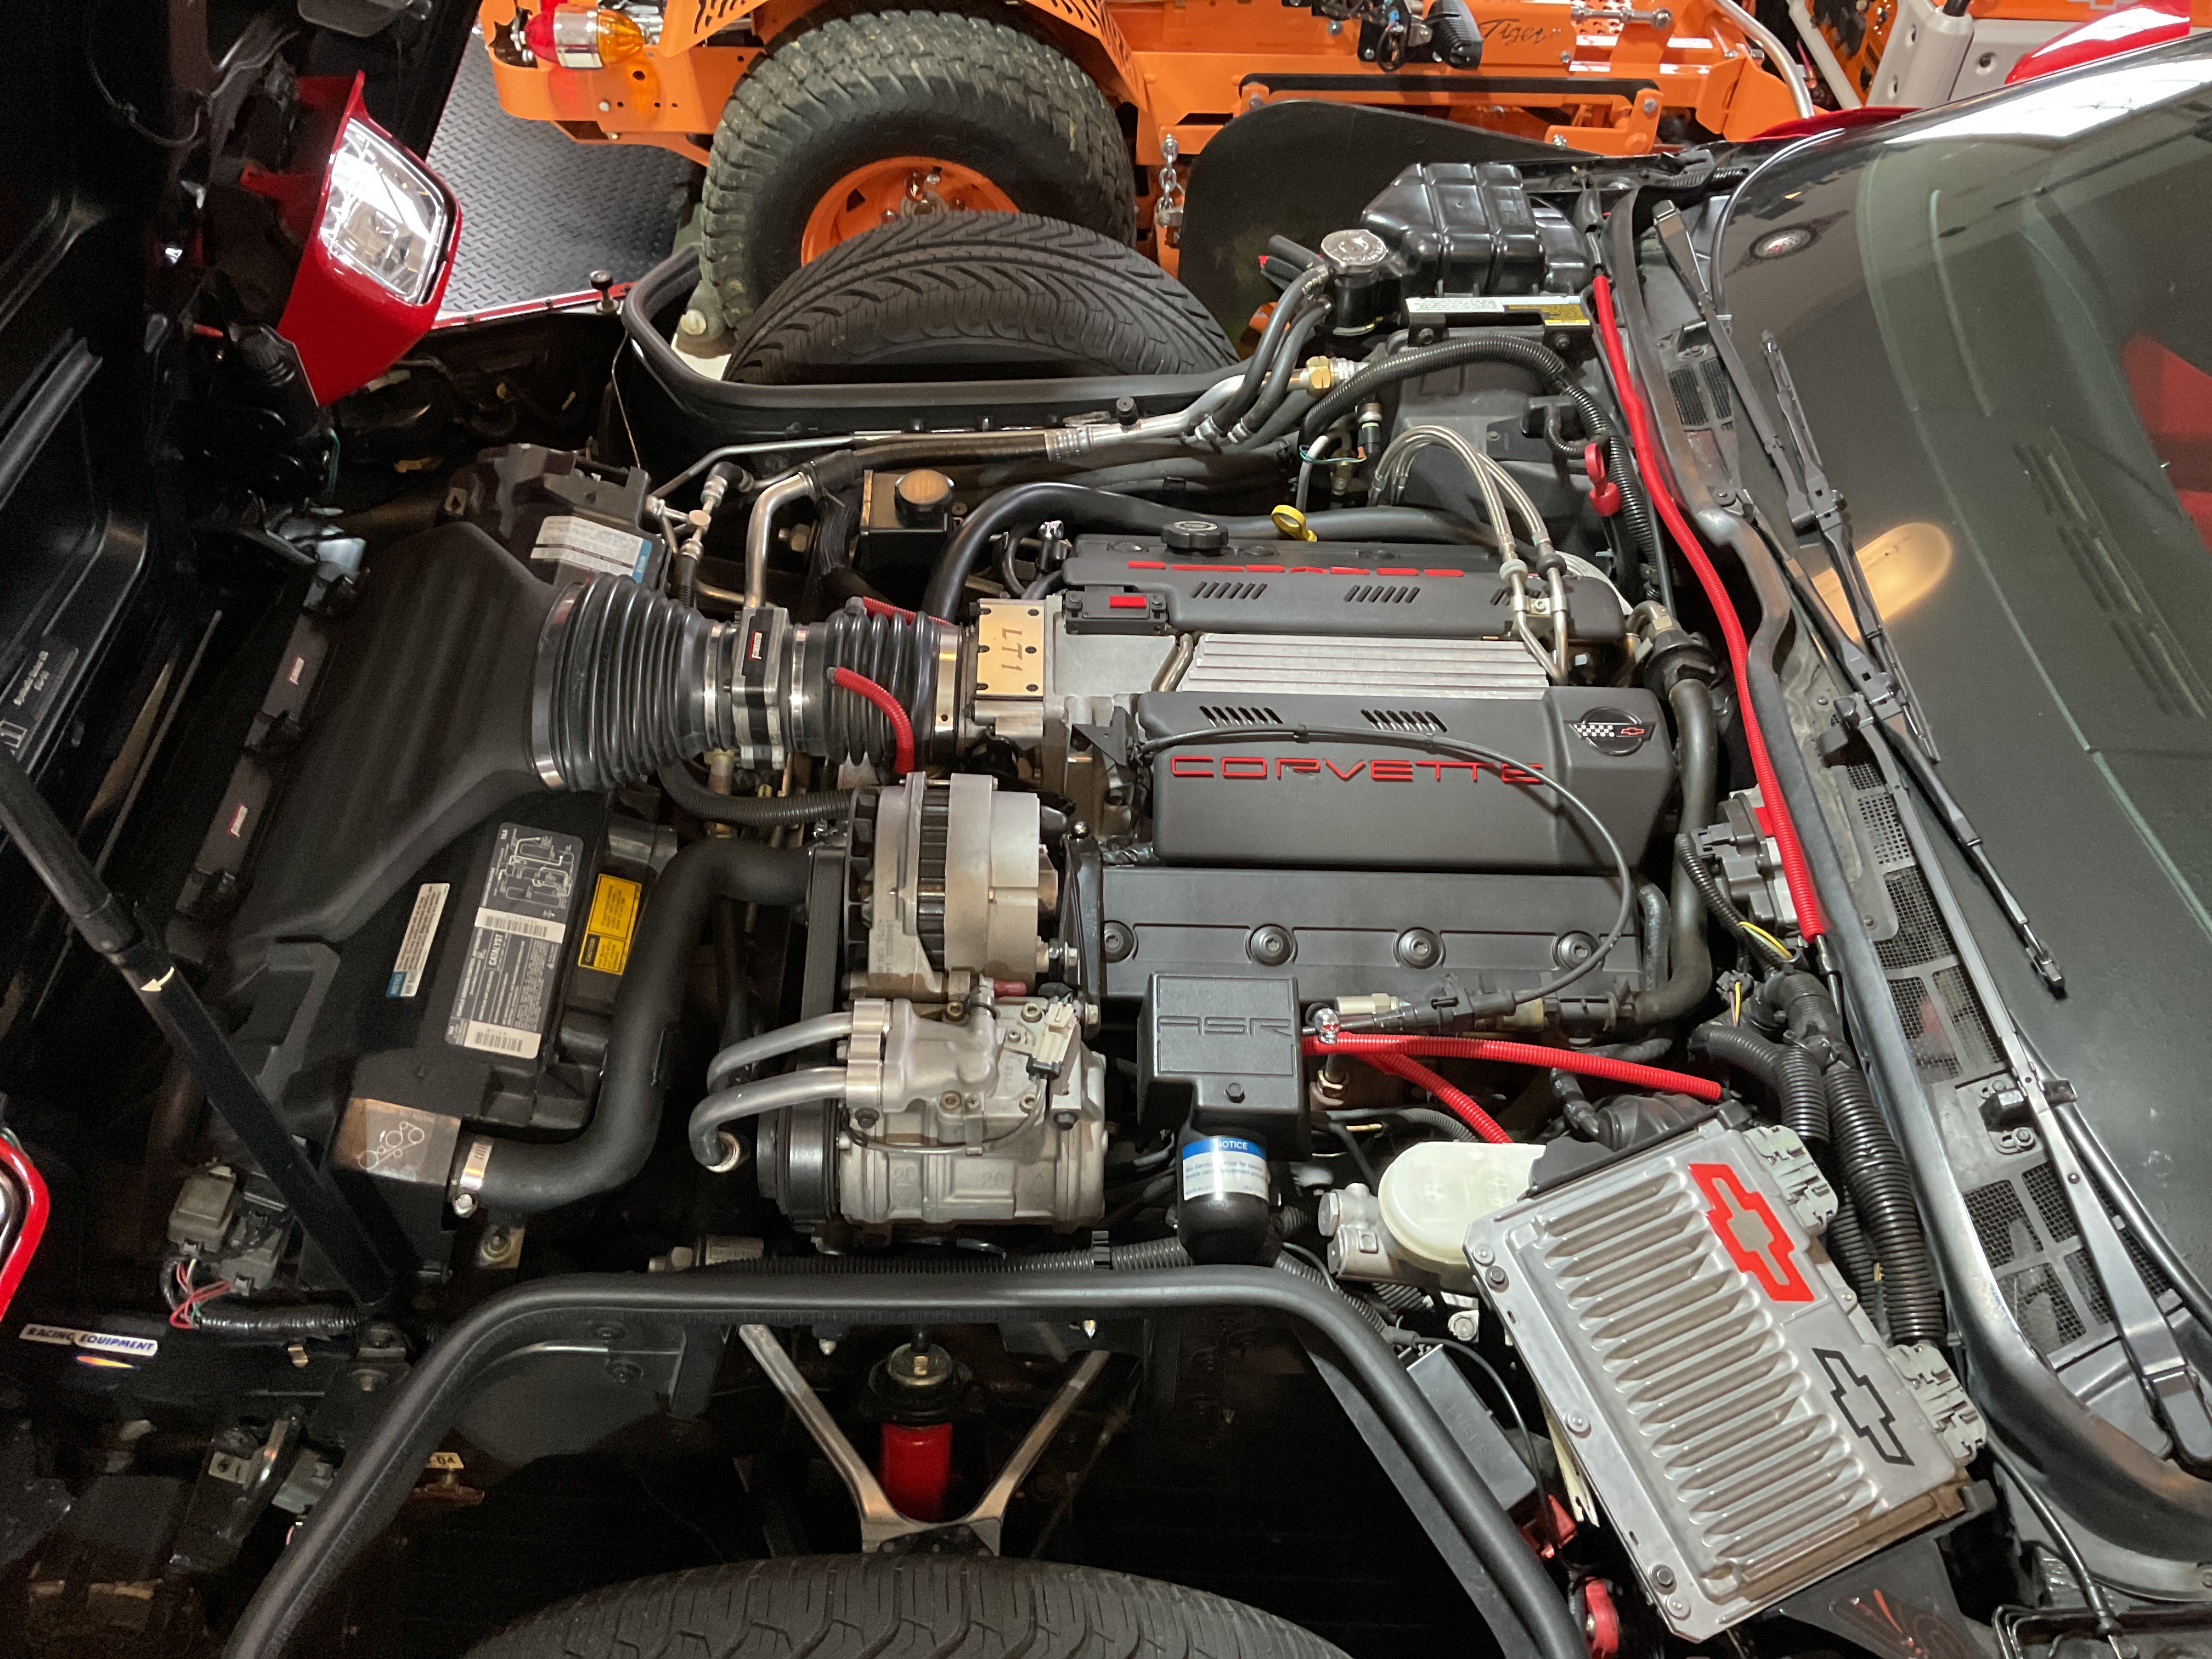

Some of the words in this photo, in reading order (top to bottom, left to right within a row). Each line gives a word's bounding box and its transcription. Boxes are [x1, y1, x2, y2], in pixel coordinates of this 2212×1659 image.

[1001, 628, 1023, 671] LT1
[1170, 755, 1543, 785] CORVETTE
[487, 933, 504, 966] CATALYST
[1157, 1015, 1294, 1037] ASR
[1217, 1141, 1248, 1149] NOTICE
[80, 1334, 154, 1351] EQUIPMENT
